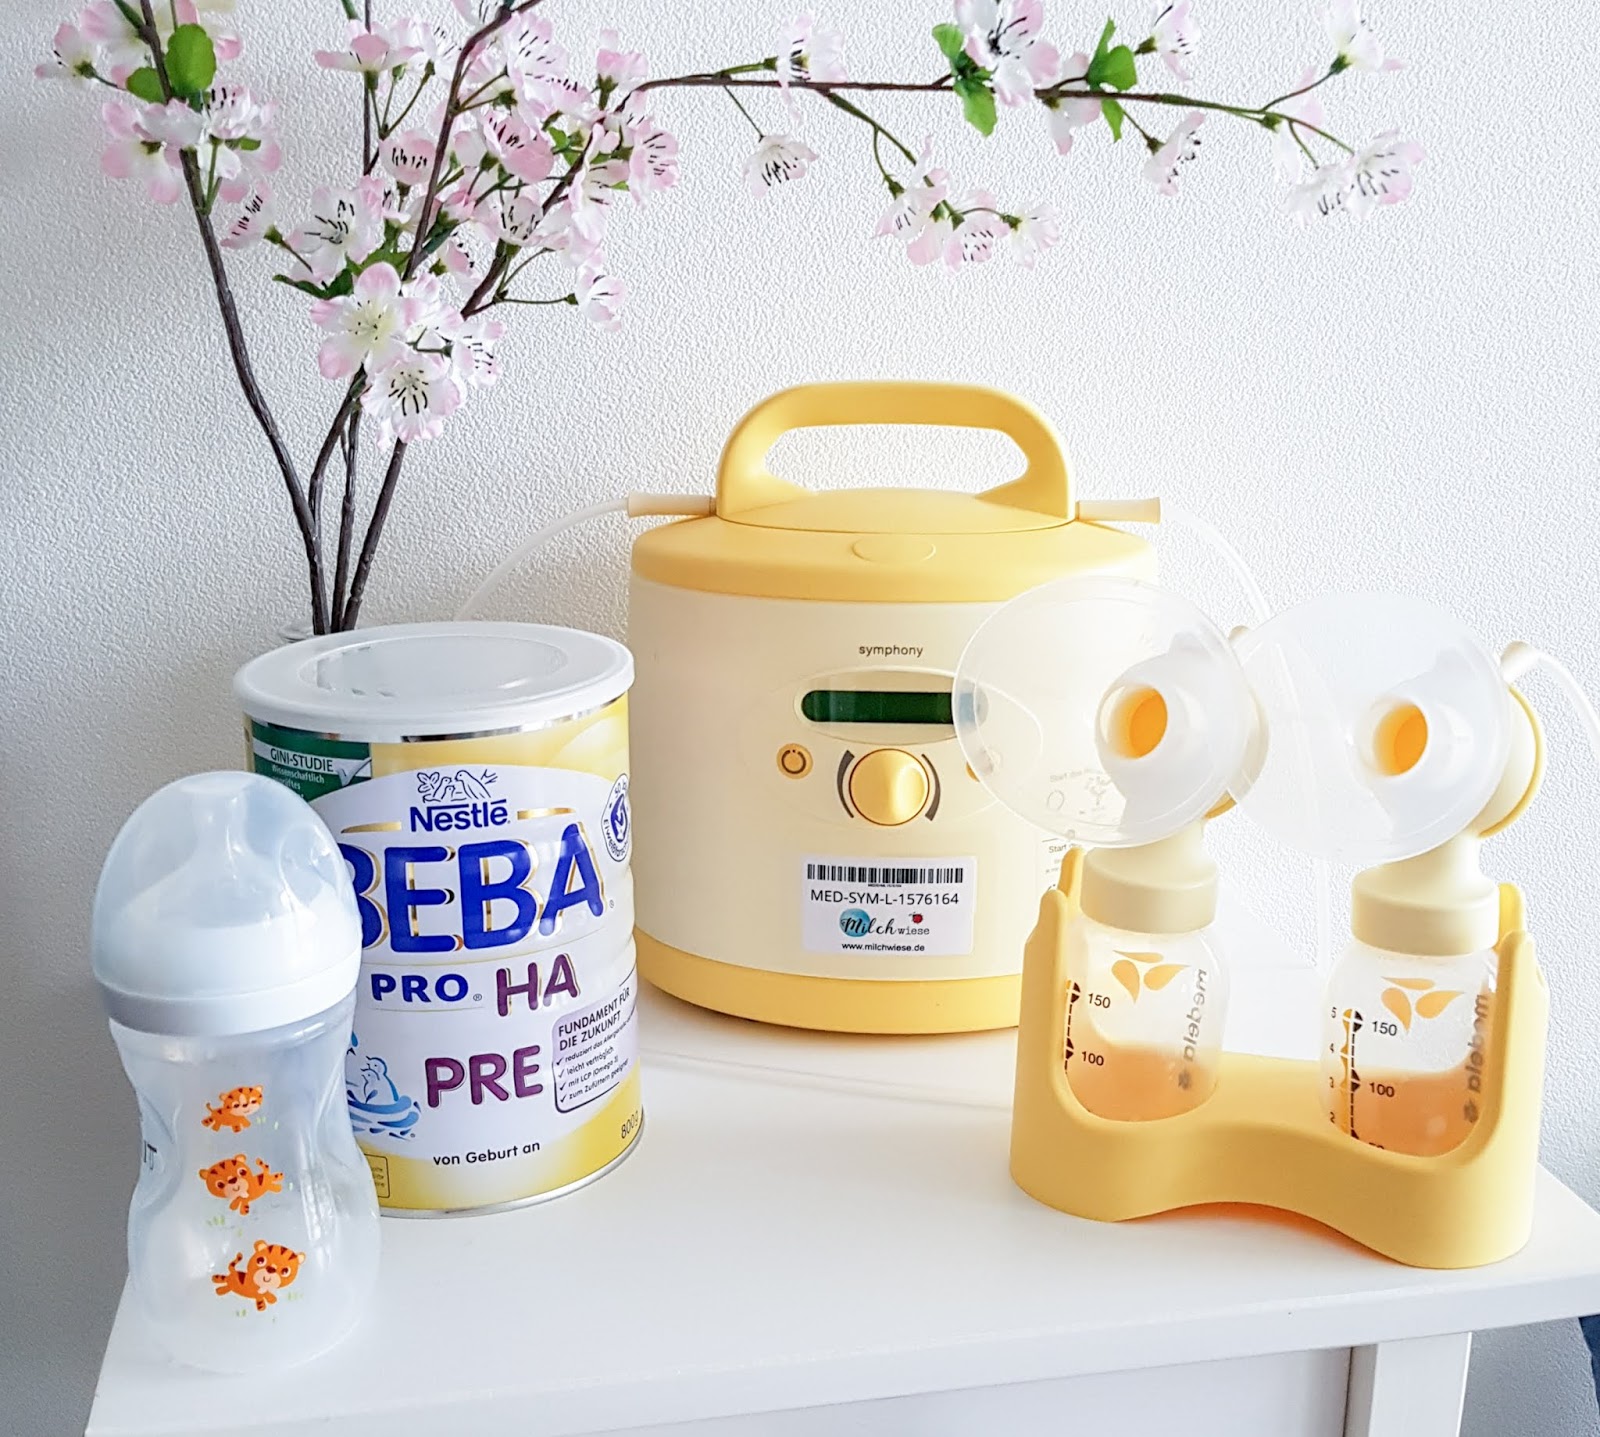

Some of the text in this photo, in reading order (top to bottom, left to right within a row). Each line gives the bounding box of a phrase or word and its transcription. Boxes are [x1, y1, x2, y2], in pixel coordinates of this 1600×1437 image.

[858, 644, 924, 658] symphony
[270, 748, 334, 773] GINI-STUDIE
[411, 799, 509, 833] Nestlé
[1048, 844, 1067, 854] Start
[810, 888, 960, 906] MED-SYM-L-1576164
[841, 942, 926, 952] www.milchwiese.de
[371, 953, 581, 1018] PRO HA
[1087, 992, 1111, 1009] 150
[558, 986, 631, 1038] FUNDAMENT FÜR
[1182, 968, 1208, 1062] medela
[1330, 1006, 1337, 1019] 5
[559, 1009, 622, 1052] DIE ZUKUNFT
[1371, 1020, 1398, 1037] 150
[1081, 1050, 1105, 1067] 100
[424, 1044, 545, 1109] PRE
[566, 1061, 585, 1076] leicht
[568, 1075, 580, 1088] mit
[580, 1069, 592, 1082] LCP
[568, 1089, 584, 1100] zum
[1368, 1081, 1395, 1098] 100
[432, 1141, 541, 1166] von Geburt an
